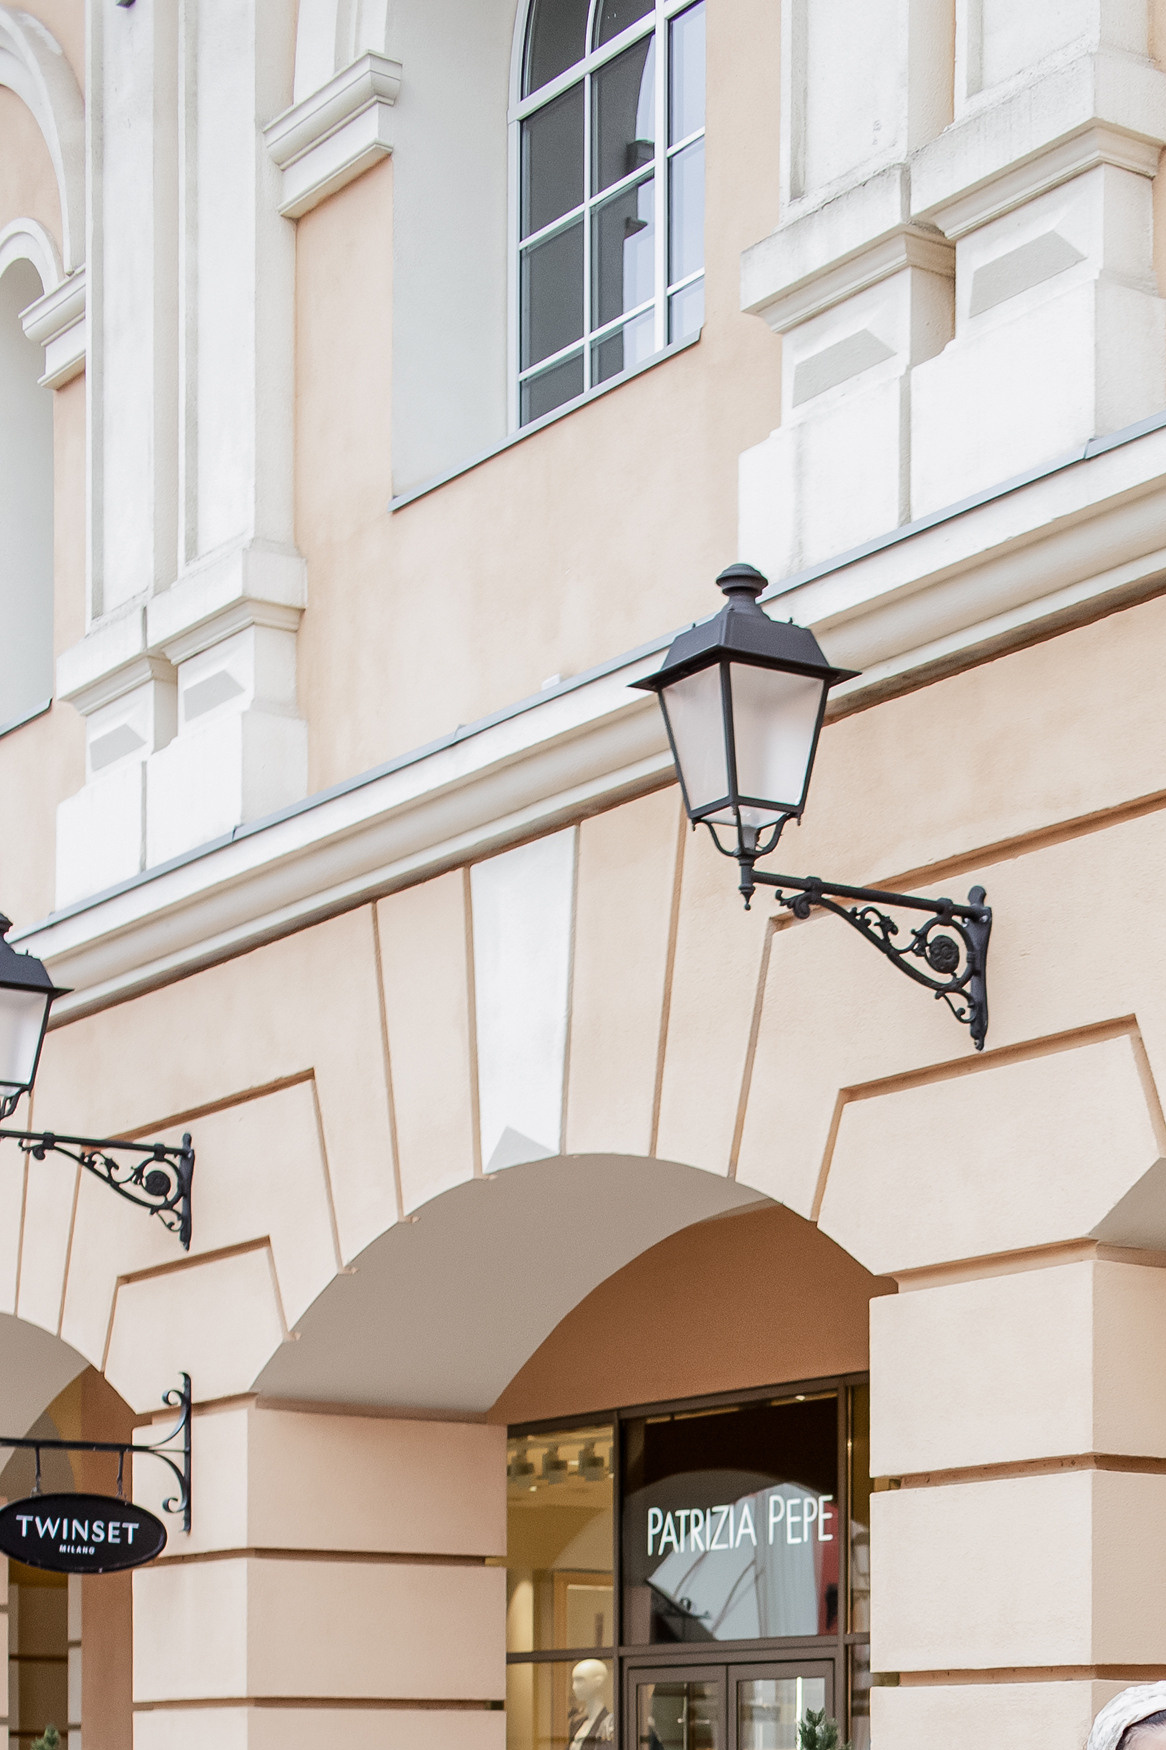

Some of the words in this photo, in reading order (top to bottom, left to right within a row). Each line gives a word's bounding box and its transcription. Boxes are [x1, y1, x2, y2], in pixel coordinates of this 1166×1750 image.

[15, 1514, 140, 1545] TWINSET
[647, 1506, 758, 1556] PATRIZIA
[768, 1494, 834, 1545] PEPE
[59, 1544, 95, 1555] MILANO
